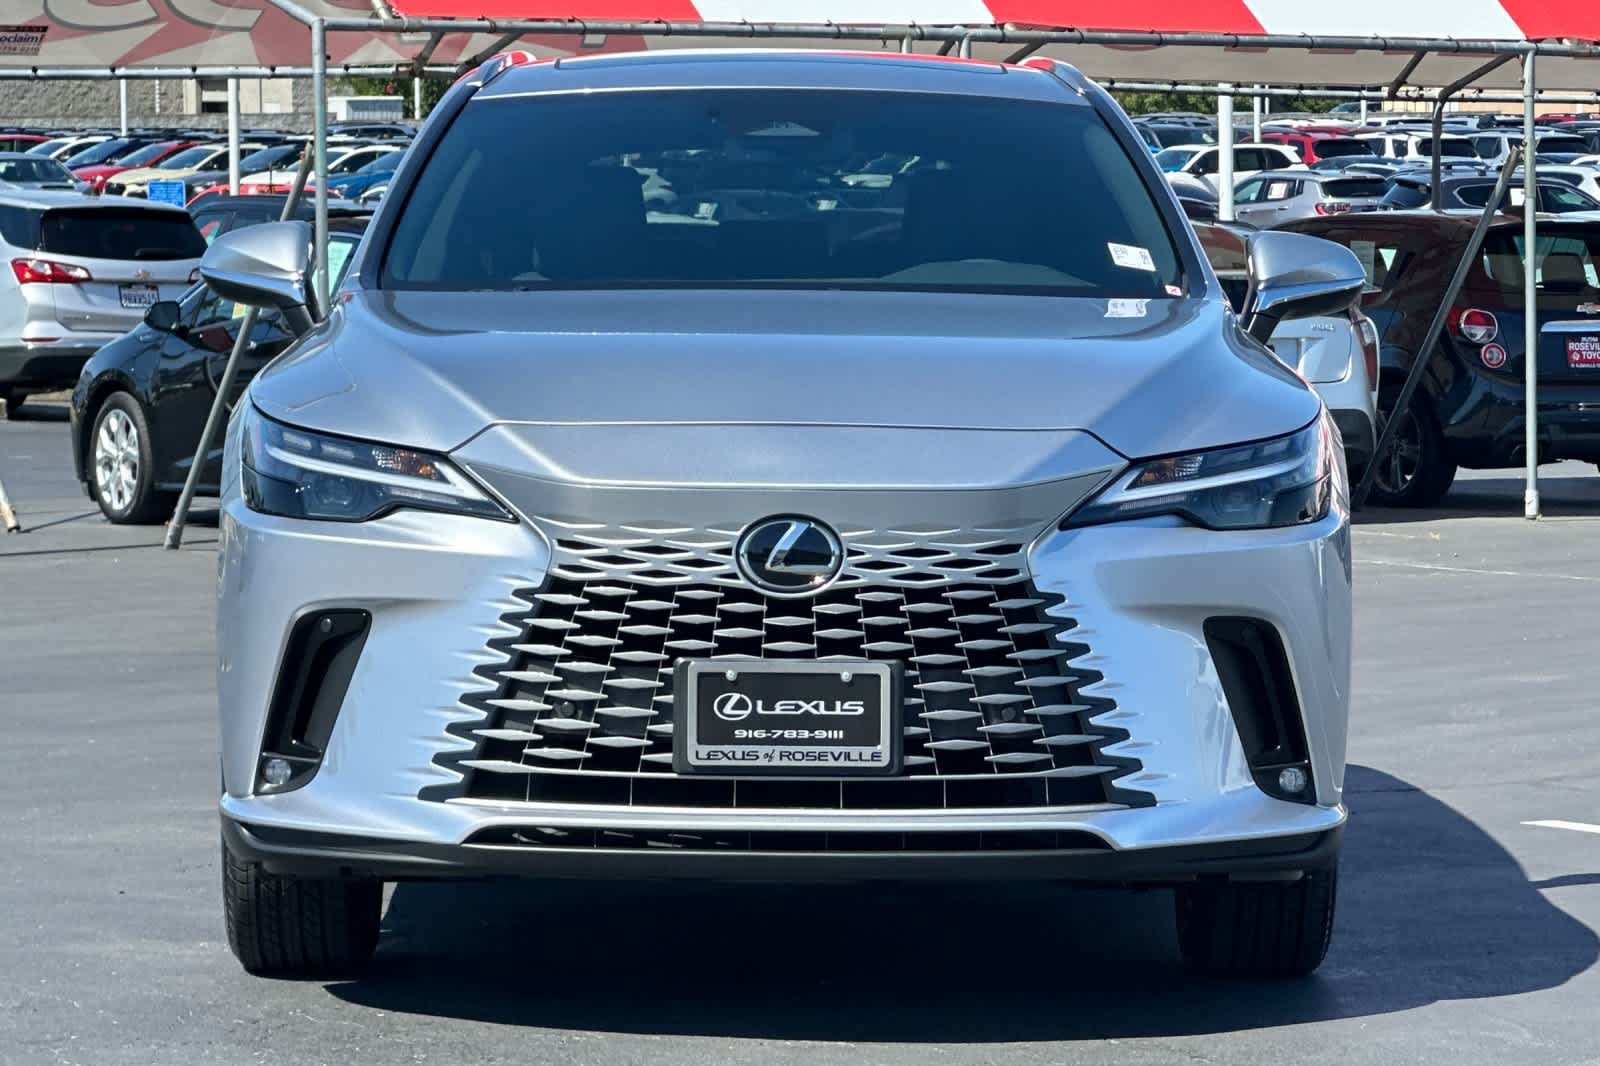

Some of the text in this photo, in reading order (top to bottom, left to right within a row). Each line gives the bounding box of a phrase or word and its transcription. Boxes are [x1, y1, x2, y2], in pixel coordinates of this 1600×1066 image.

[756, 700, 865, 715] LEXUS
[734, 729, 844, 739] 916-783-9111
[695, 749, 882, 762] LEXUS of ROSEVILLE
